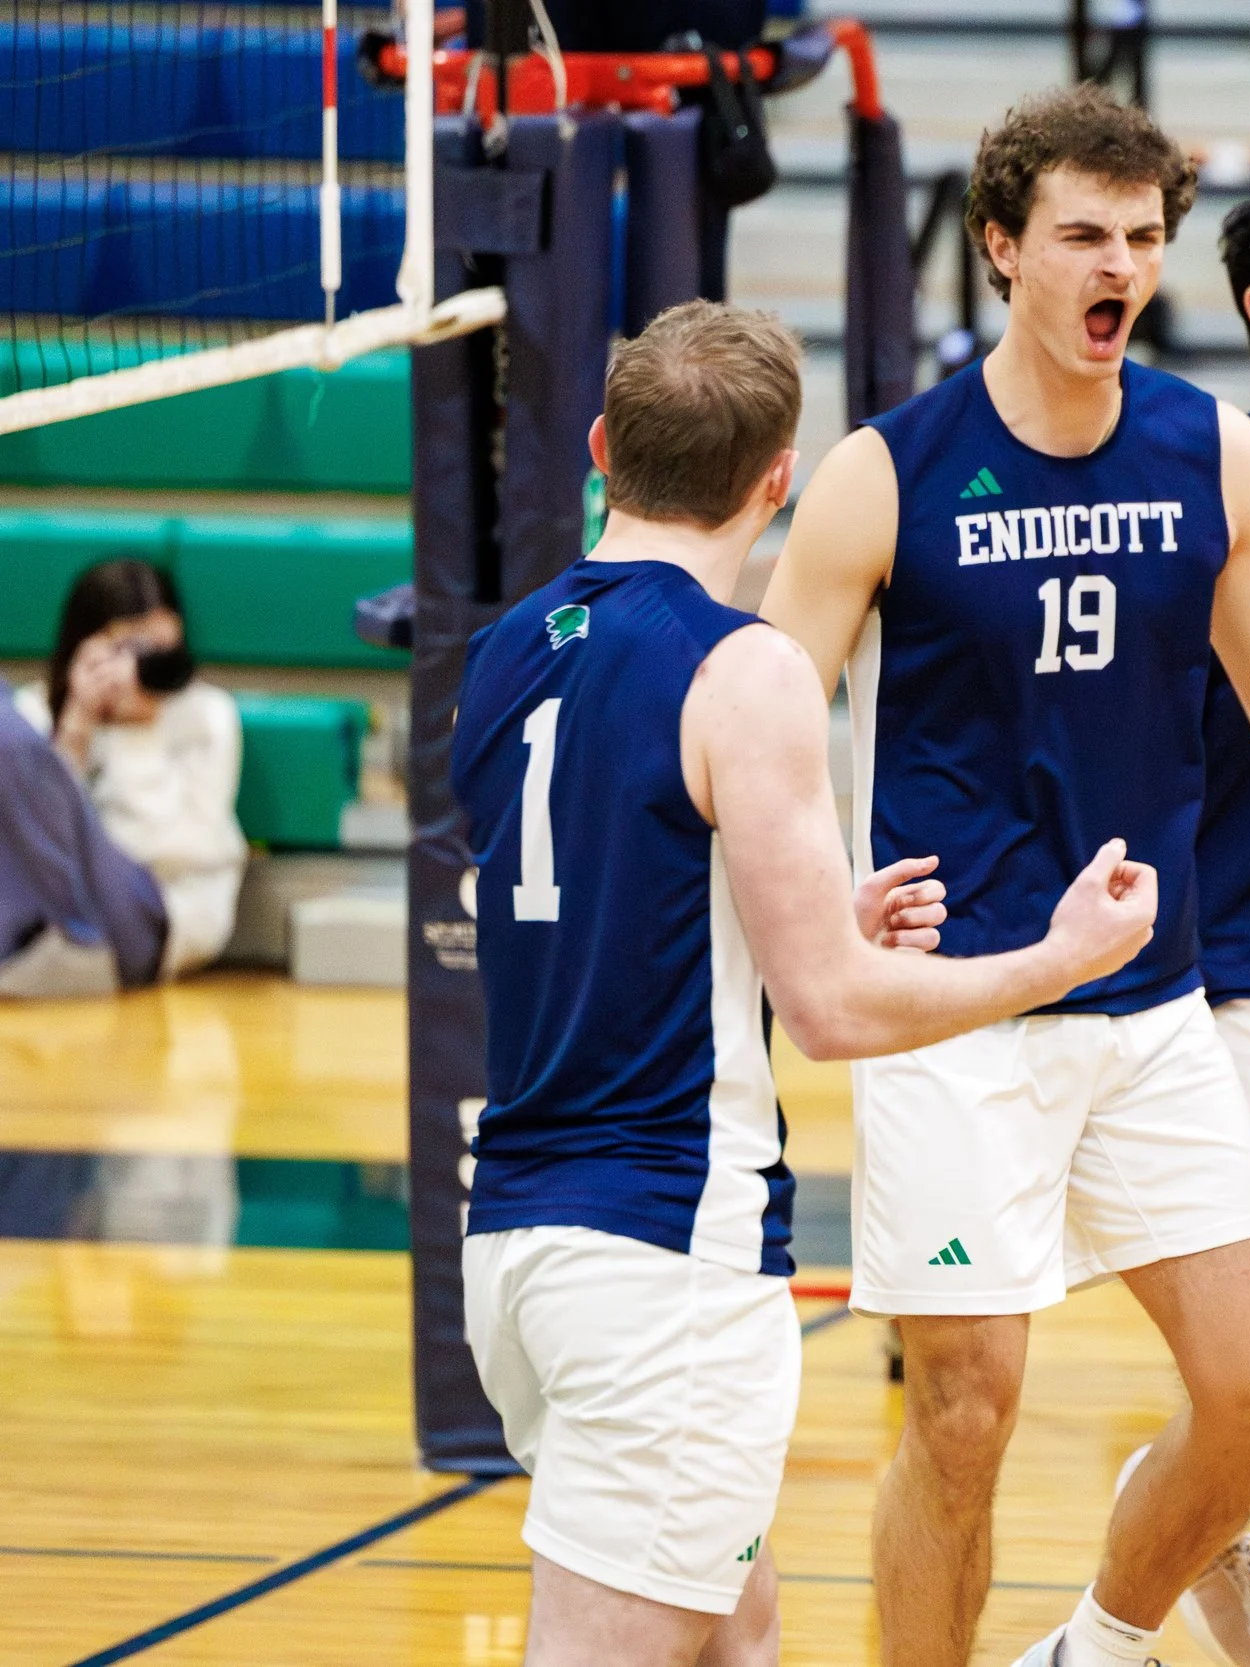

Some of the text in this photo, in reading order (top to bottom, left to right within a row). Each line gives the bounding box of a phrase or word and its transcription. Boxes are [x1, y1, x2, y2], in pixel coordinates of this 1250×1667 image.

[955, 502, 1183, 566] ENDICOTT
[1034, 575, 1117, 674] 19
[513, 698, 562, 922] 1
